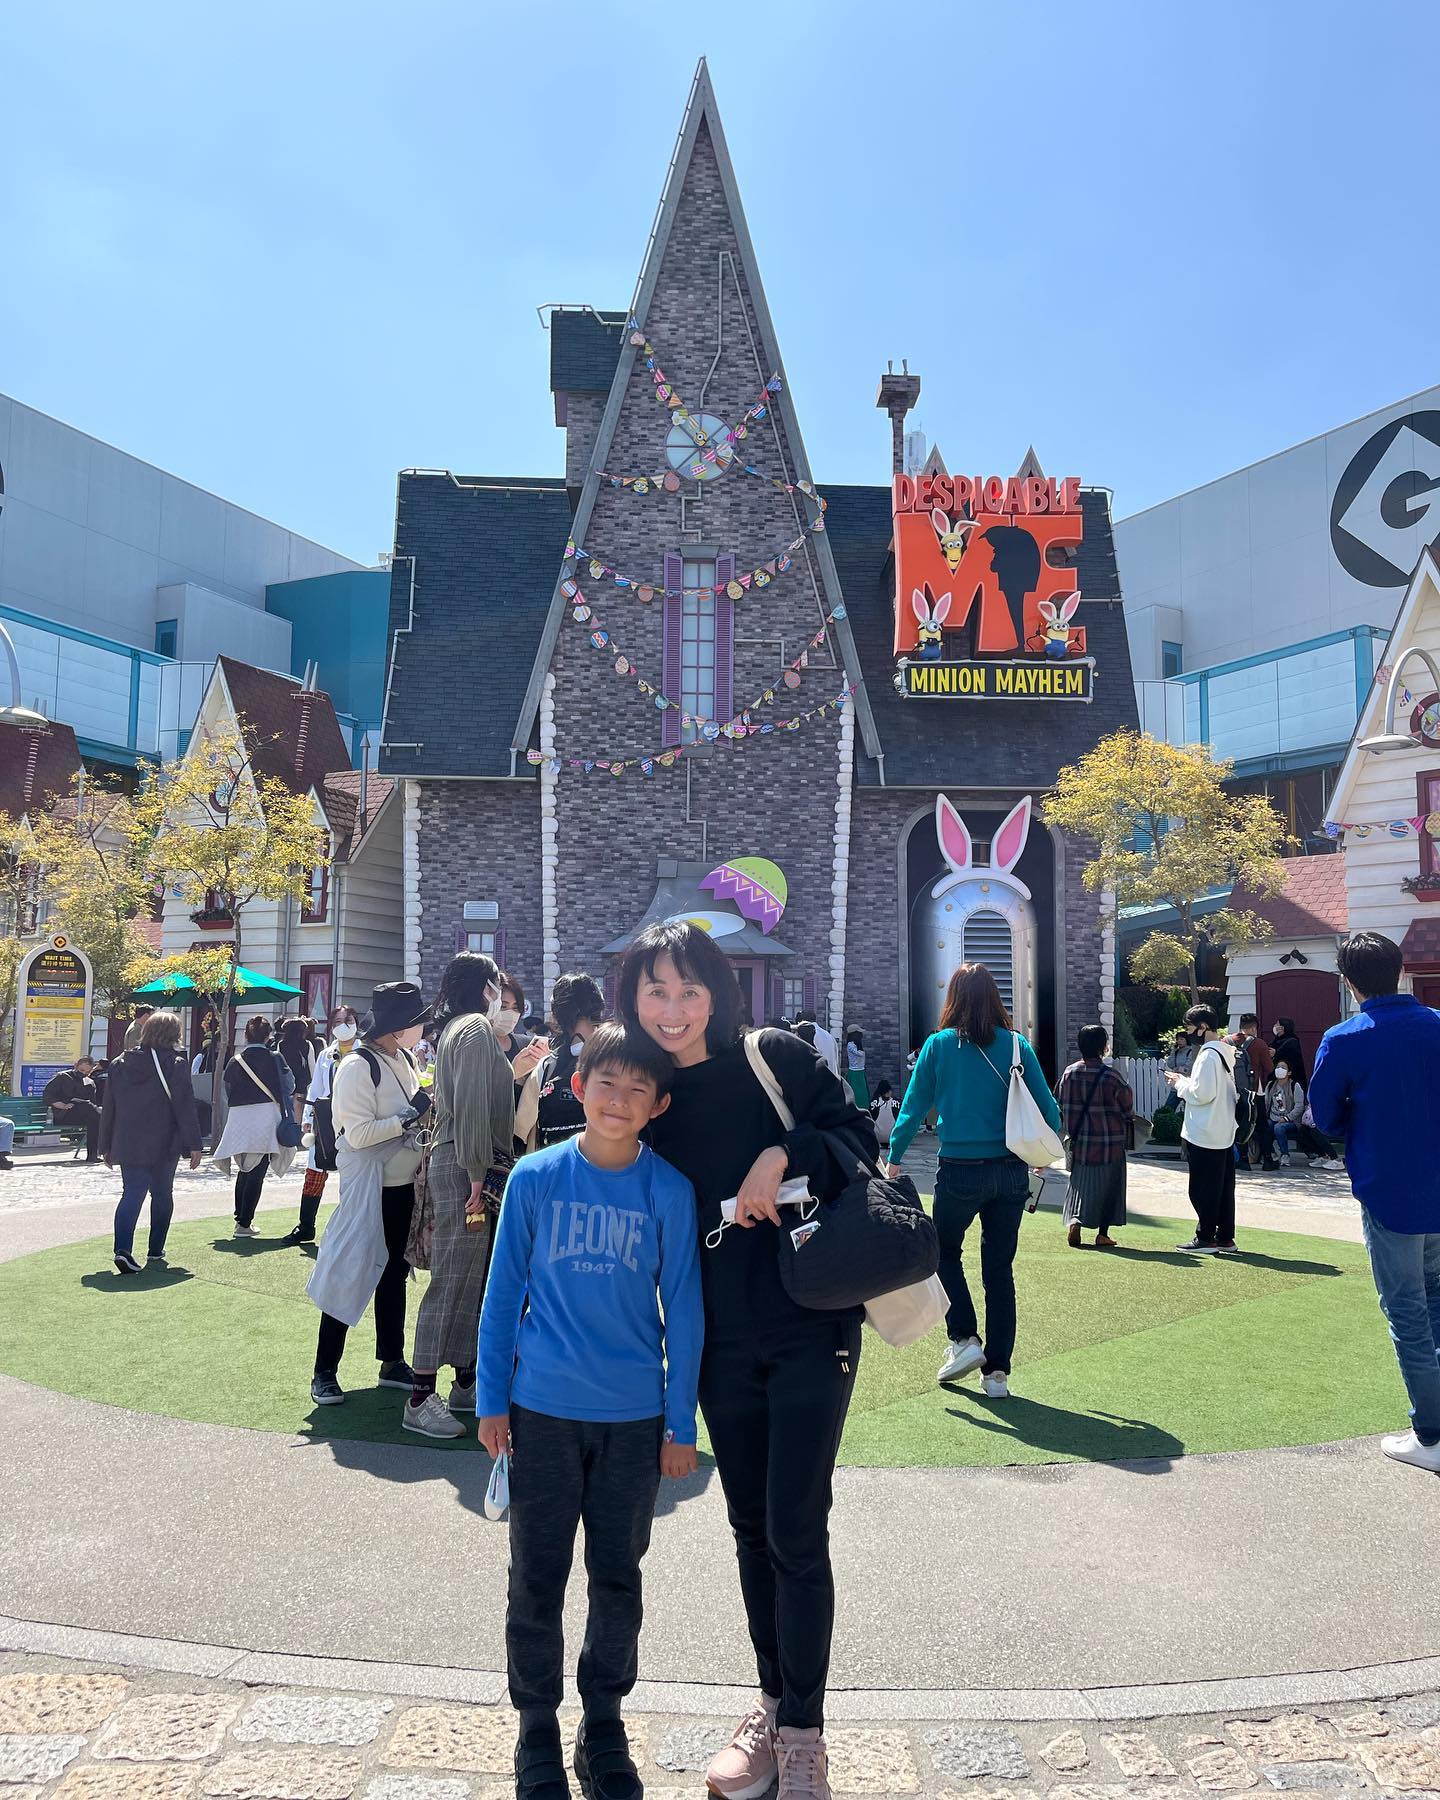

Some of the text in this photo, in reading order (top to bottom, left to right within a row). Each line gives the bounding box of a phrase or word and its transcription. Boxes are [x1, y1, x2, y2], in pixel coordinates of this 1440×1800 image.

[894, 474, 1083, 513] DESPICABLE
[893, 512, 1087, 654] ME
[910, 667, 1083, 694] MINION MAYHEM
[550, 1201, 643, 1272] LEONE
[572, 1261, 615, 1274] 1947
